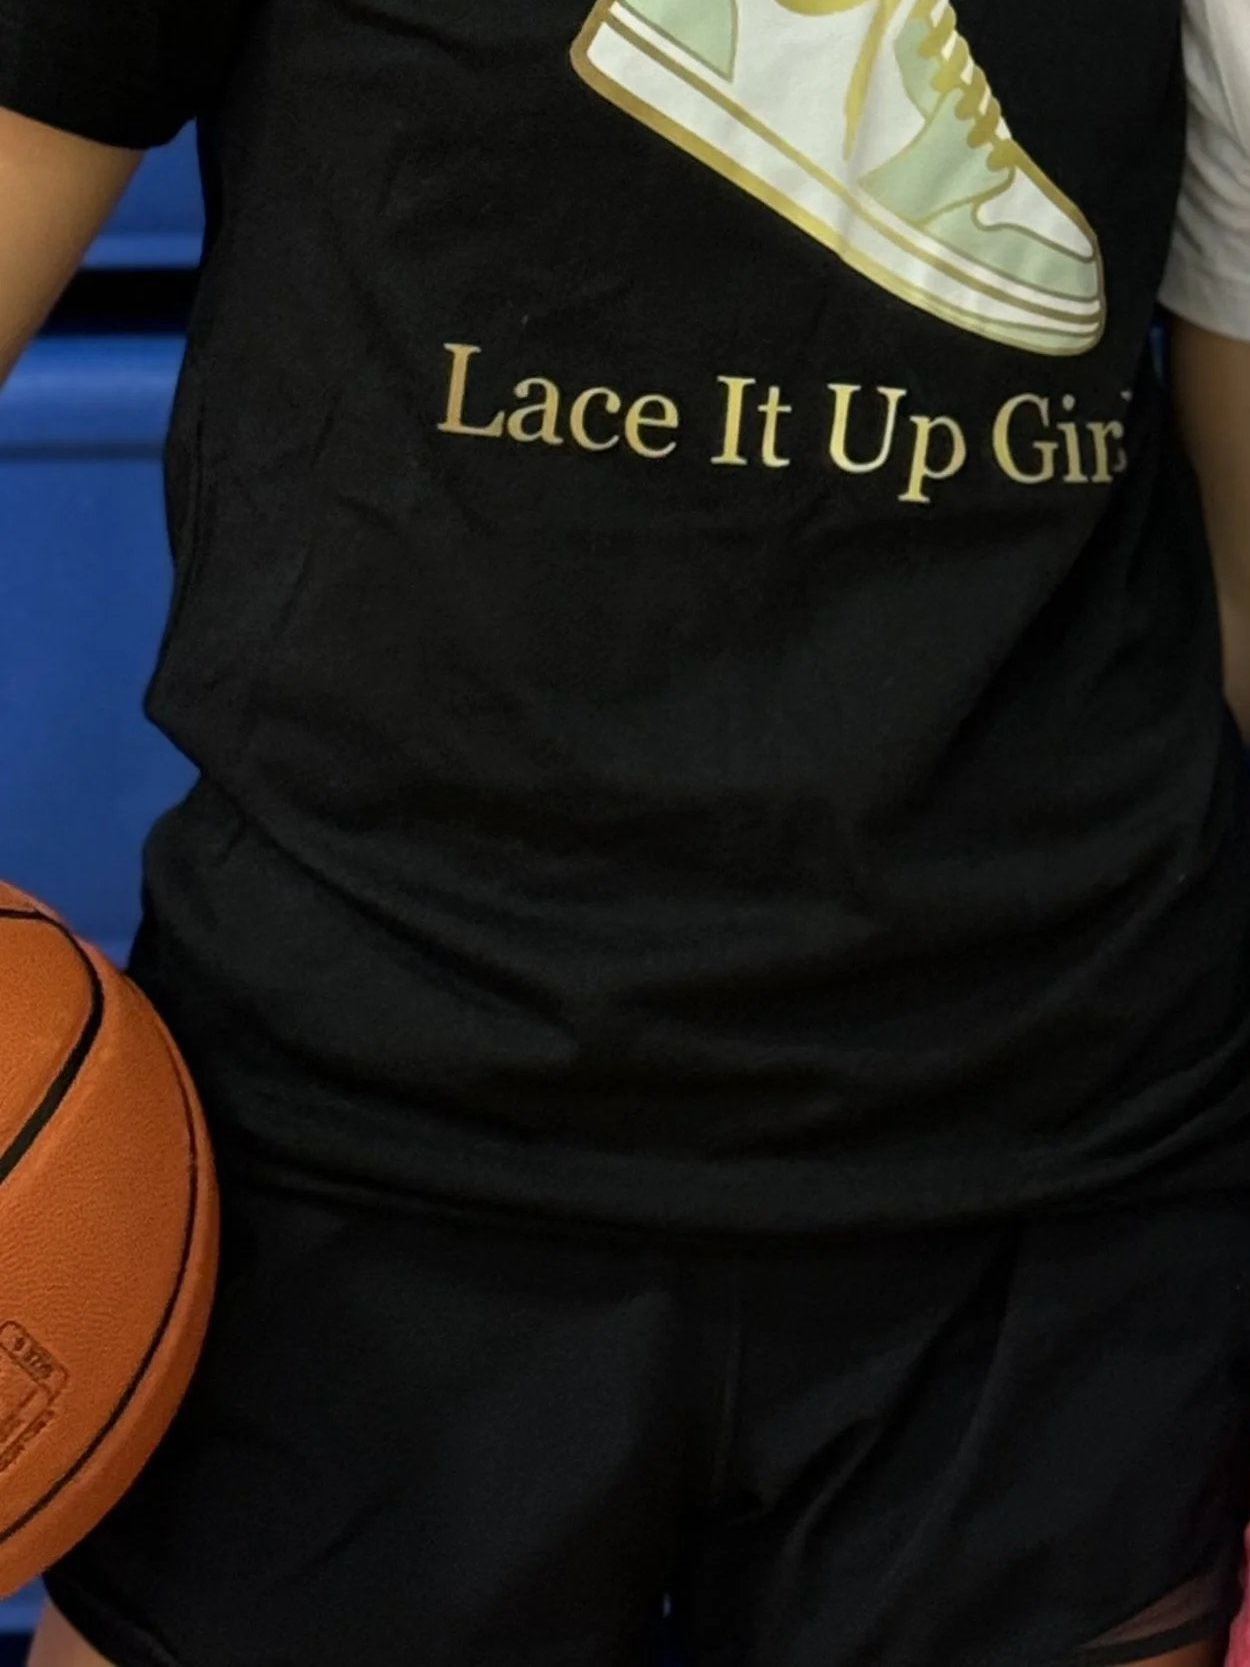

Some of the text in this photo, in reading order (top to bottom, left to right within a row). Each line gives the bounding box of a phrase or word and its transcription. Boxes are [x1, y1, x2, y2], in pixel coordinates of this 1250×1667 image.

[437, 342, 680, 458] Lace
[710, 375, 792, 468] It
[826, 382, 968, 503] Up
